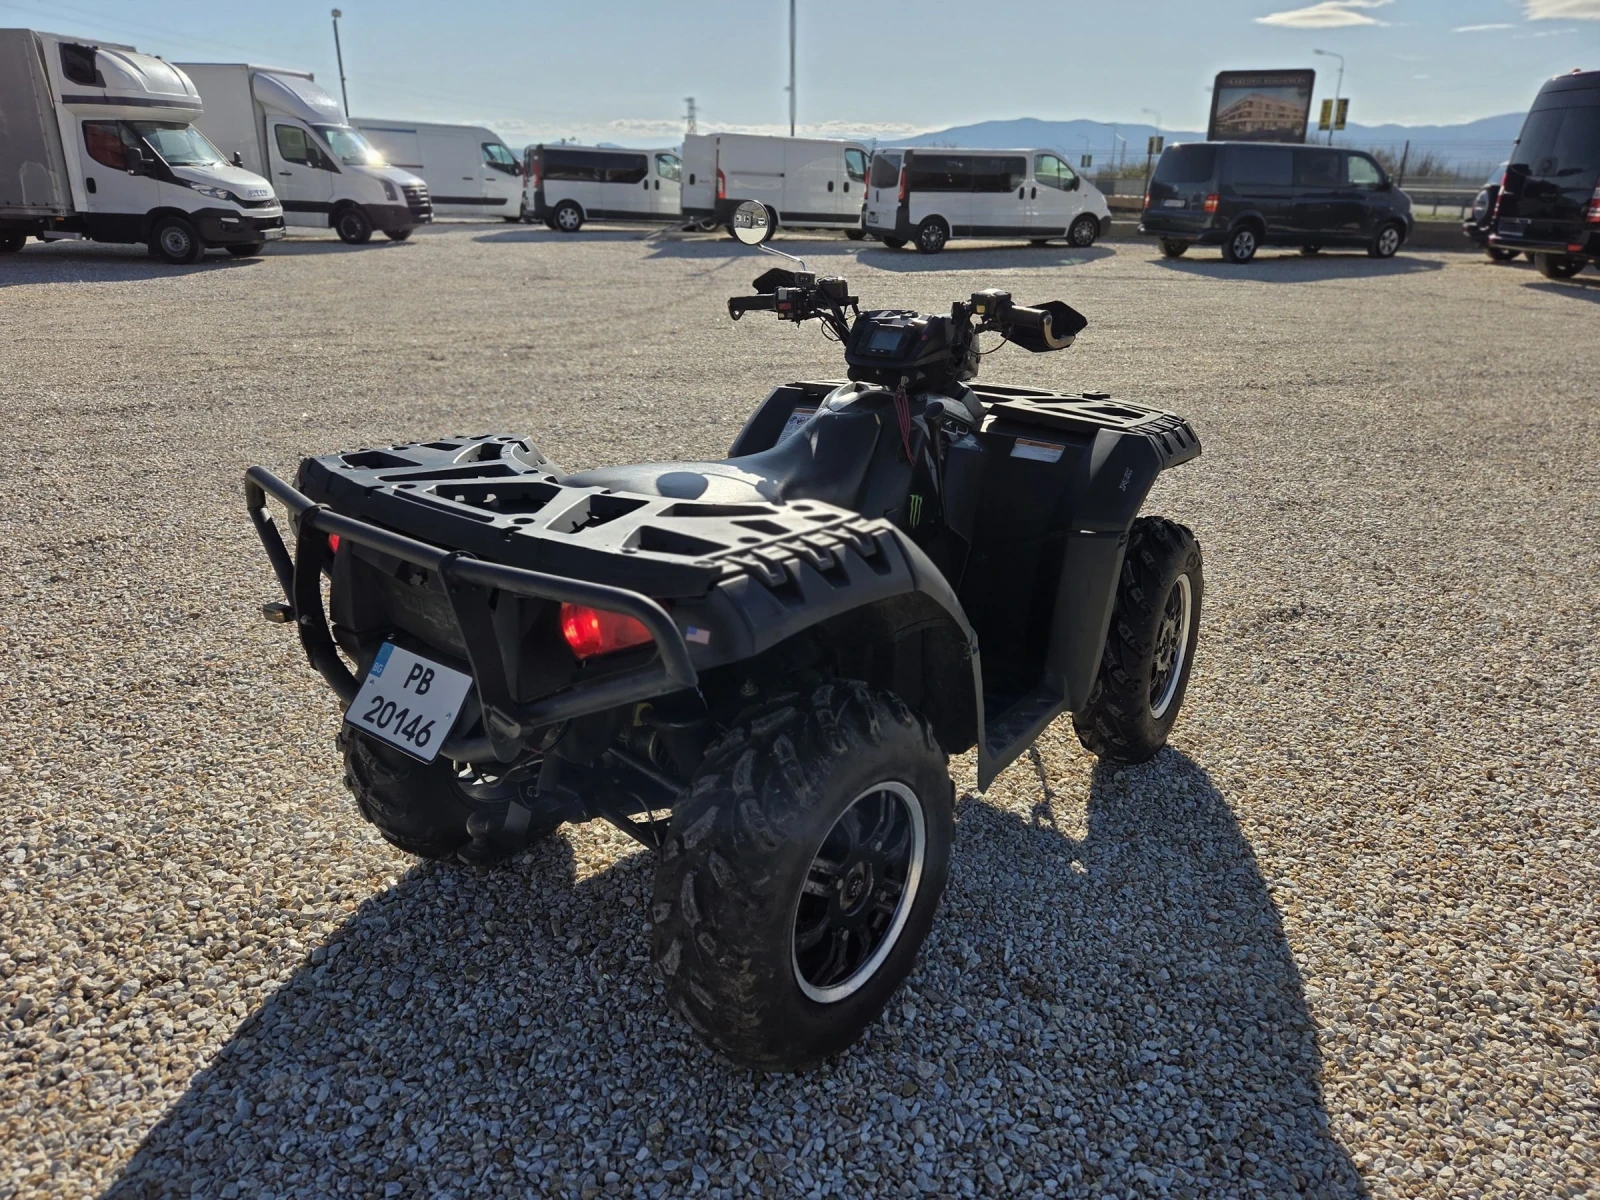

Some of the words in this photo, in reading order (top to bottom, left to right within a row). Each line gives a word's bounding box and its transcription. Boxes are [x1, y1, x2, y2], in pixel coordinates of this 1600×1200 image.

[372, 662, 384, 673] BG
[403, 663, 435, 695] PB
[362, 696, 436, 747] 20146
